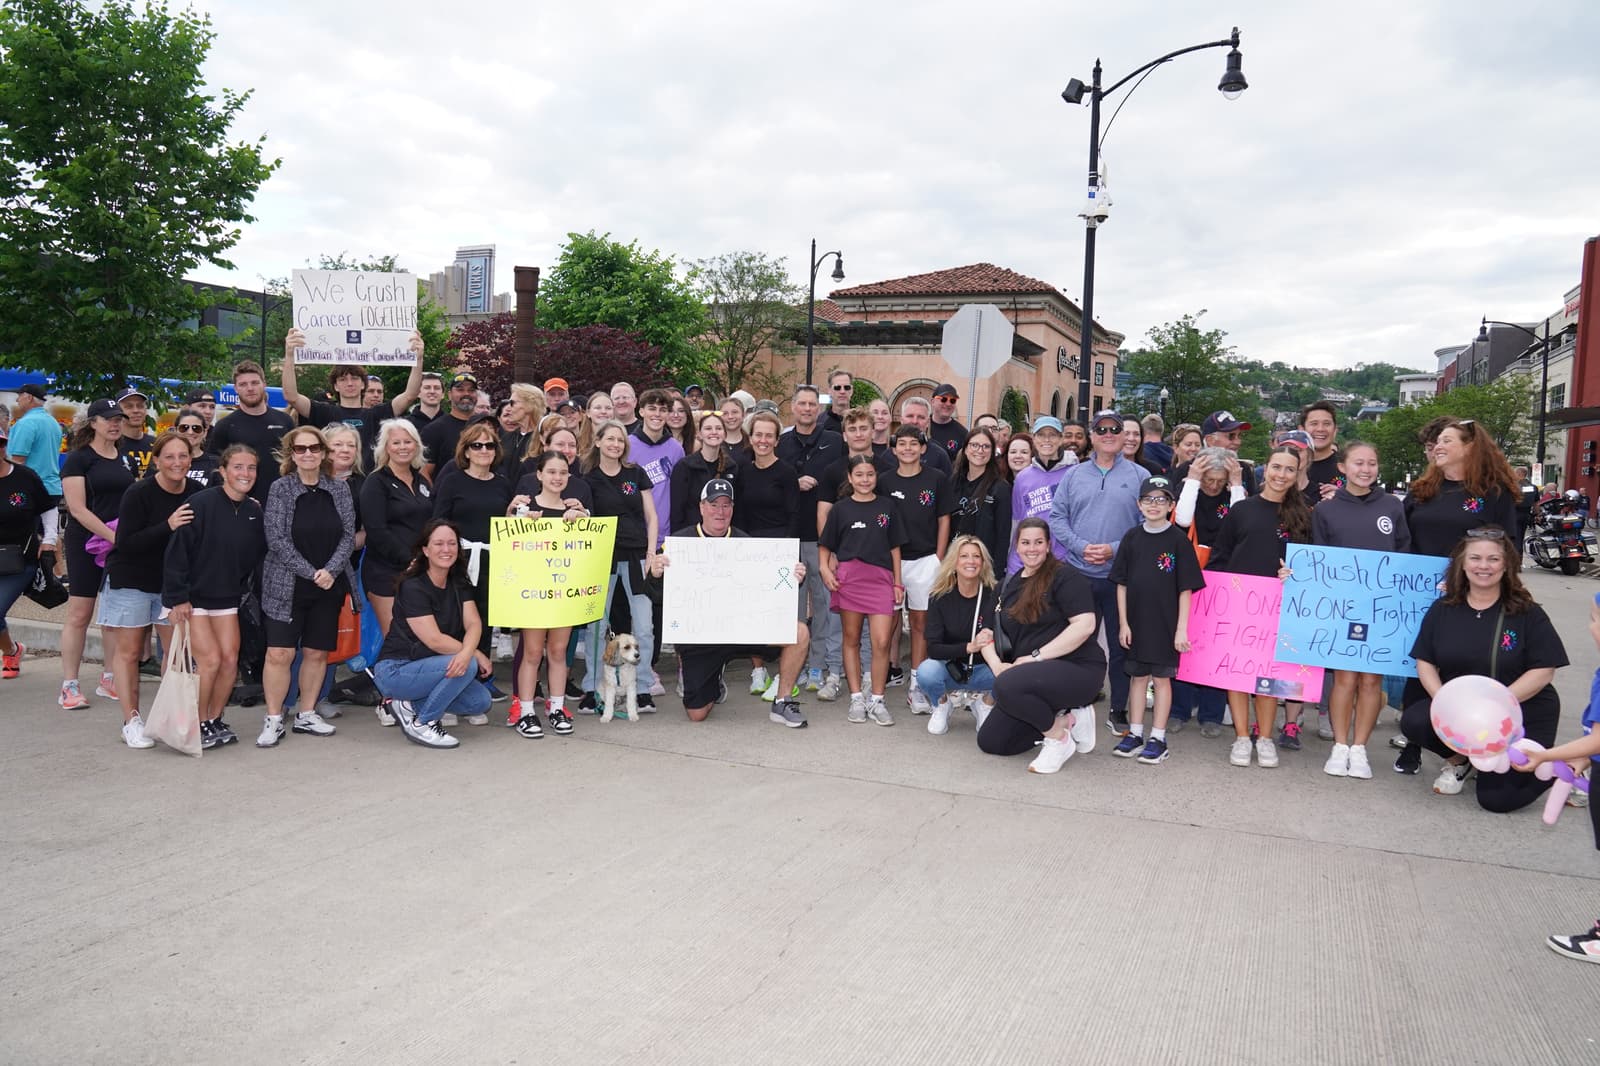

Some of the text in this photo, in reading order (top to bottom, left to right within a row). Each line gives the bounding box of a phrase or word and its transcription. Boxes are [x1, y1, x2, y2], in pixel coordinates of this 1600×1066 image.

[300, 273, 406, 304] We Crush
[469, 264, 483, 300] WORKS
[297, 305, 417, 331] Cancer TOGETHER
[1028, 486, 1049, 498] EVERY
[1031, 494, 1052, 507] MILE
[495, 519, 553, 541] Hillman
[512, 540, 593, 551] FIGHTS WITH
[545, 558, 571, 568] YOU
[551, 573, 567, 583] TO
[521, 585, 603, 600] CRUSH CANCER
[1193, 585, 1230, 617] NO
[1287, 589, 1312, 618] No
[1215, 652, 1281, 677] ALONE
